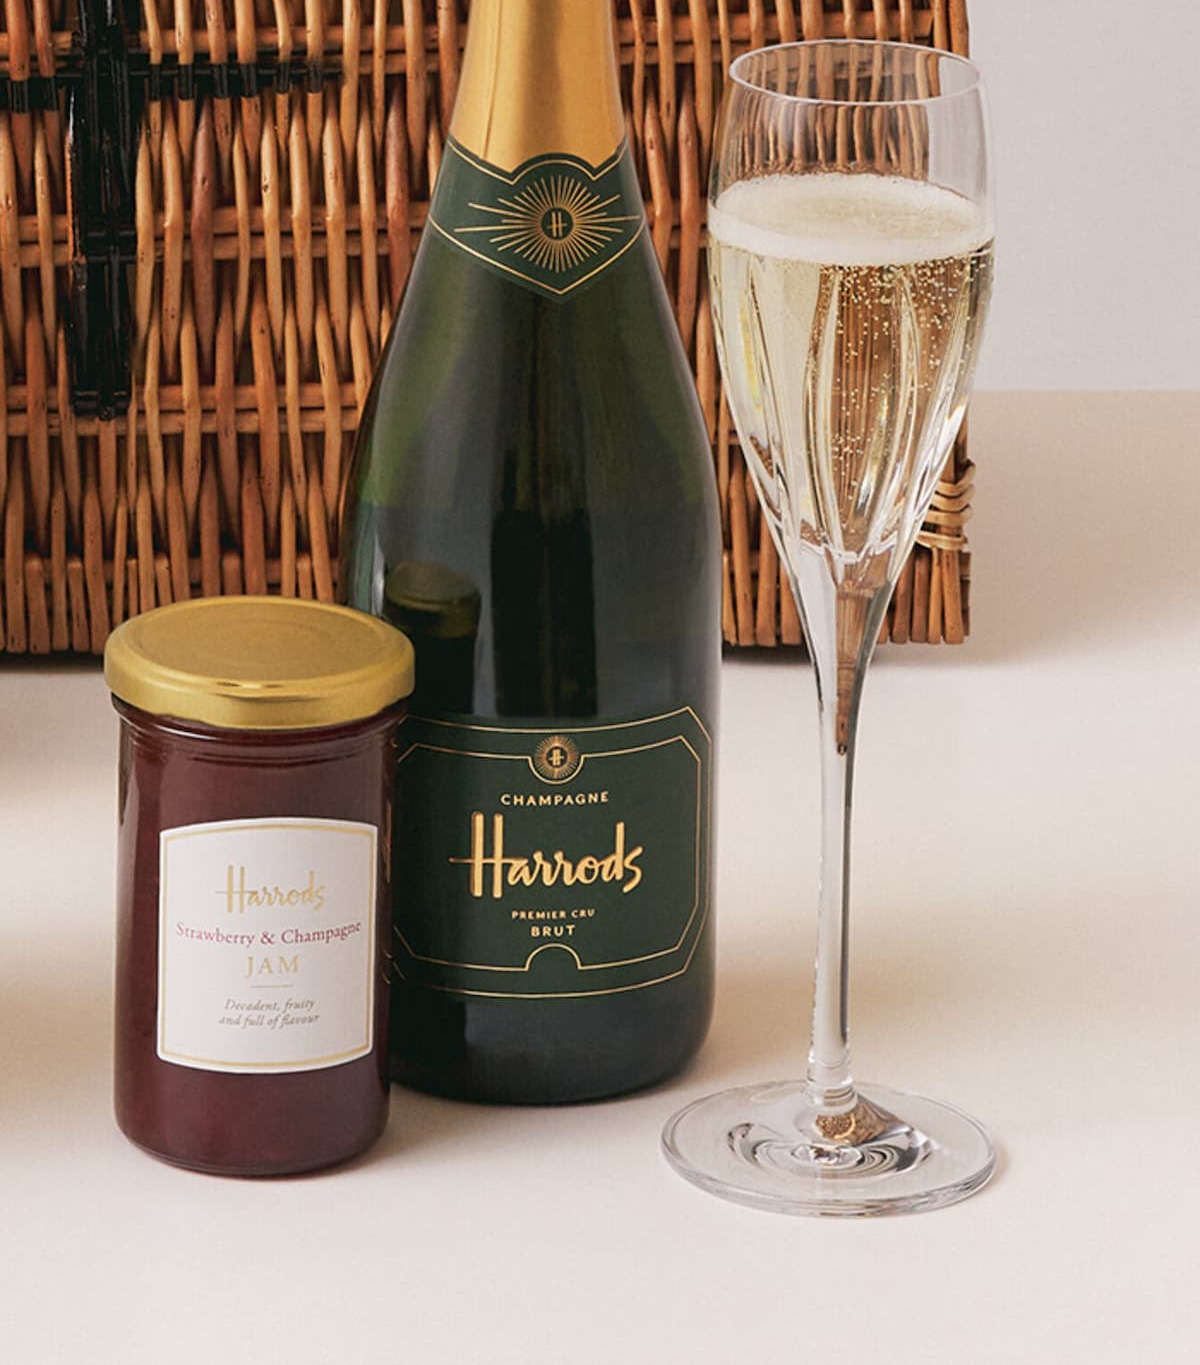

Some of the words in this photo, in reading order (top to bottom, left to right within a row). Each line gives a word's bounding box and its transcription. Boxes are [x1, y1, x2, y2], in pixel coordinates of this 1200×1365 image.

[500, 790, 609, 806] CHAMPAGNE
[448, 811, 644, 899] Harrods
[216, 865, 327, 914] Harrods
[511, 909, 567, 919] PREMIER
[571, 908, 596, 919] CRU
[176, 922, 256, 948] Strawberry
[260, 931, 276, 946] &
[281, 921, 362, 945] Champagne
[530, 924, 576, 938] BRUT
[245, 955, 300, 978] JAM
[224, 998, 281, 1012] Decadent,
[283, 997, 316, 1014] fruity
[218, 1014, 241, 1026] and
[243, 1013, 264, 1029] full
[266, 1014, 282, 1030] of
[281, 1013, 320, 1028] flavour
